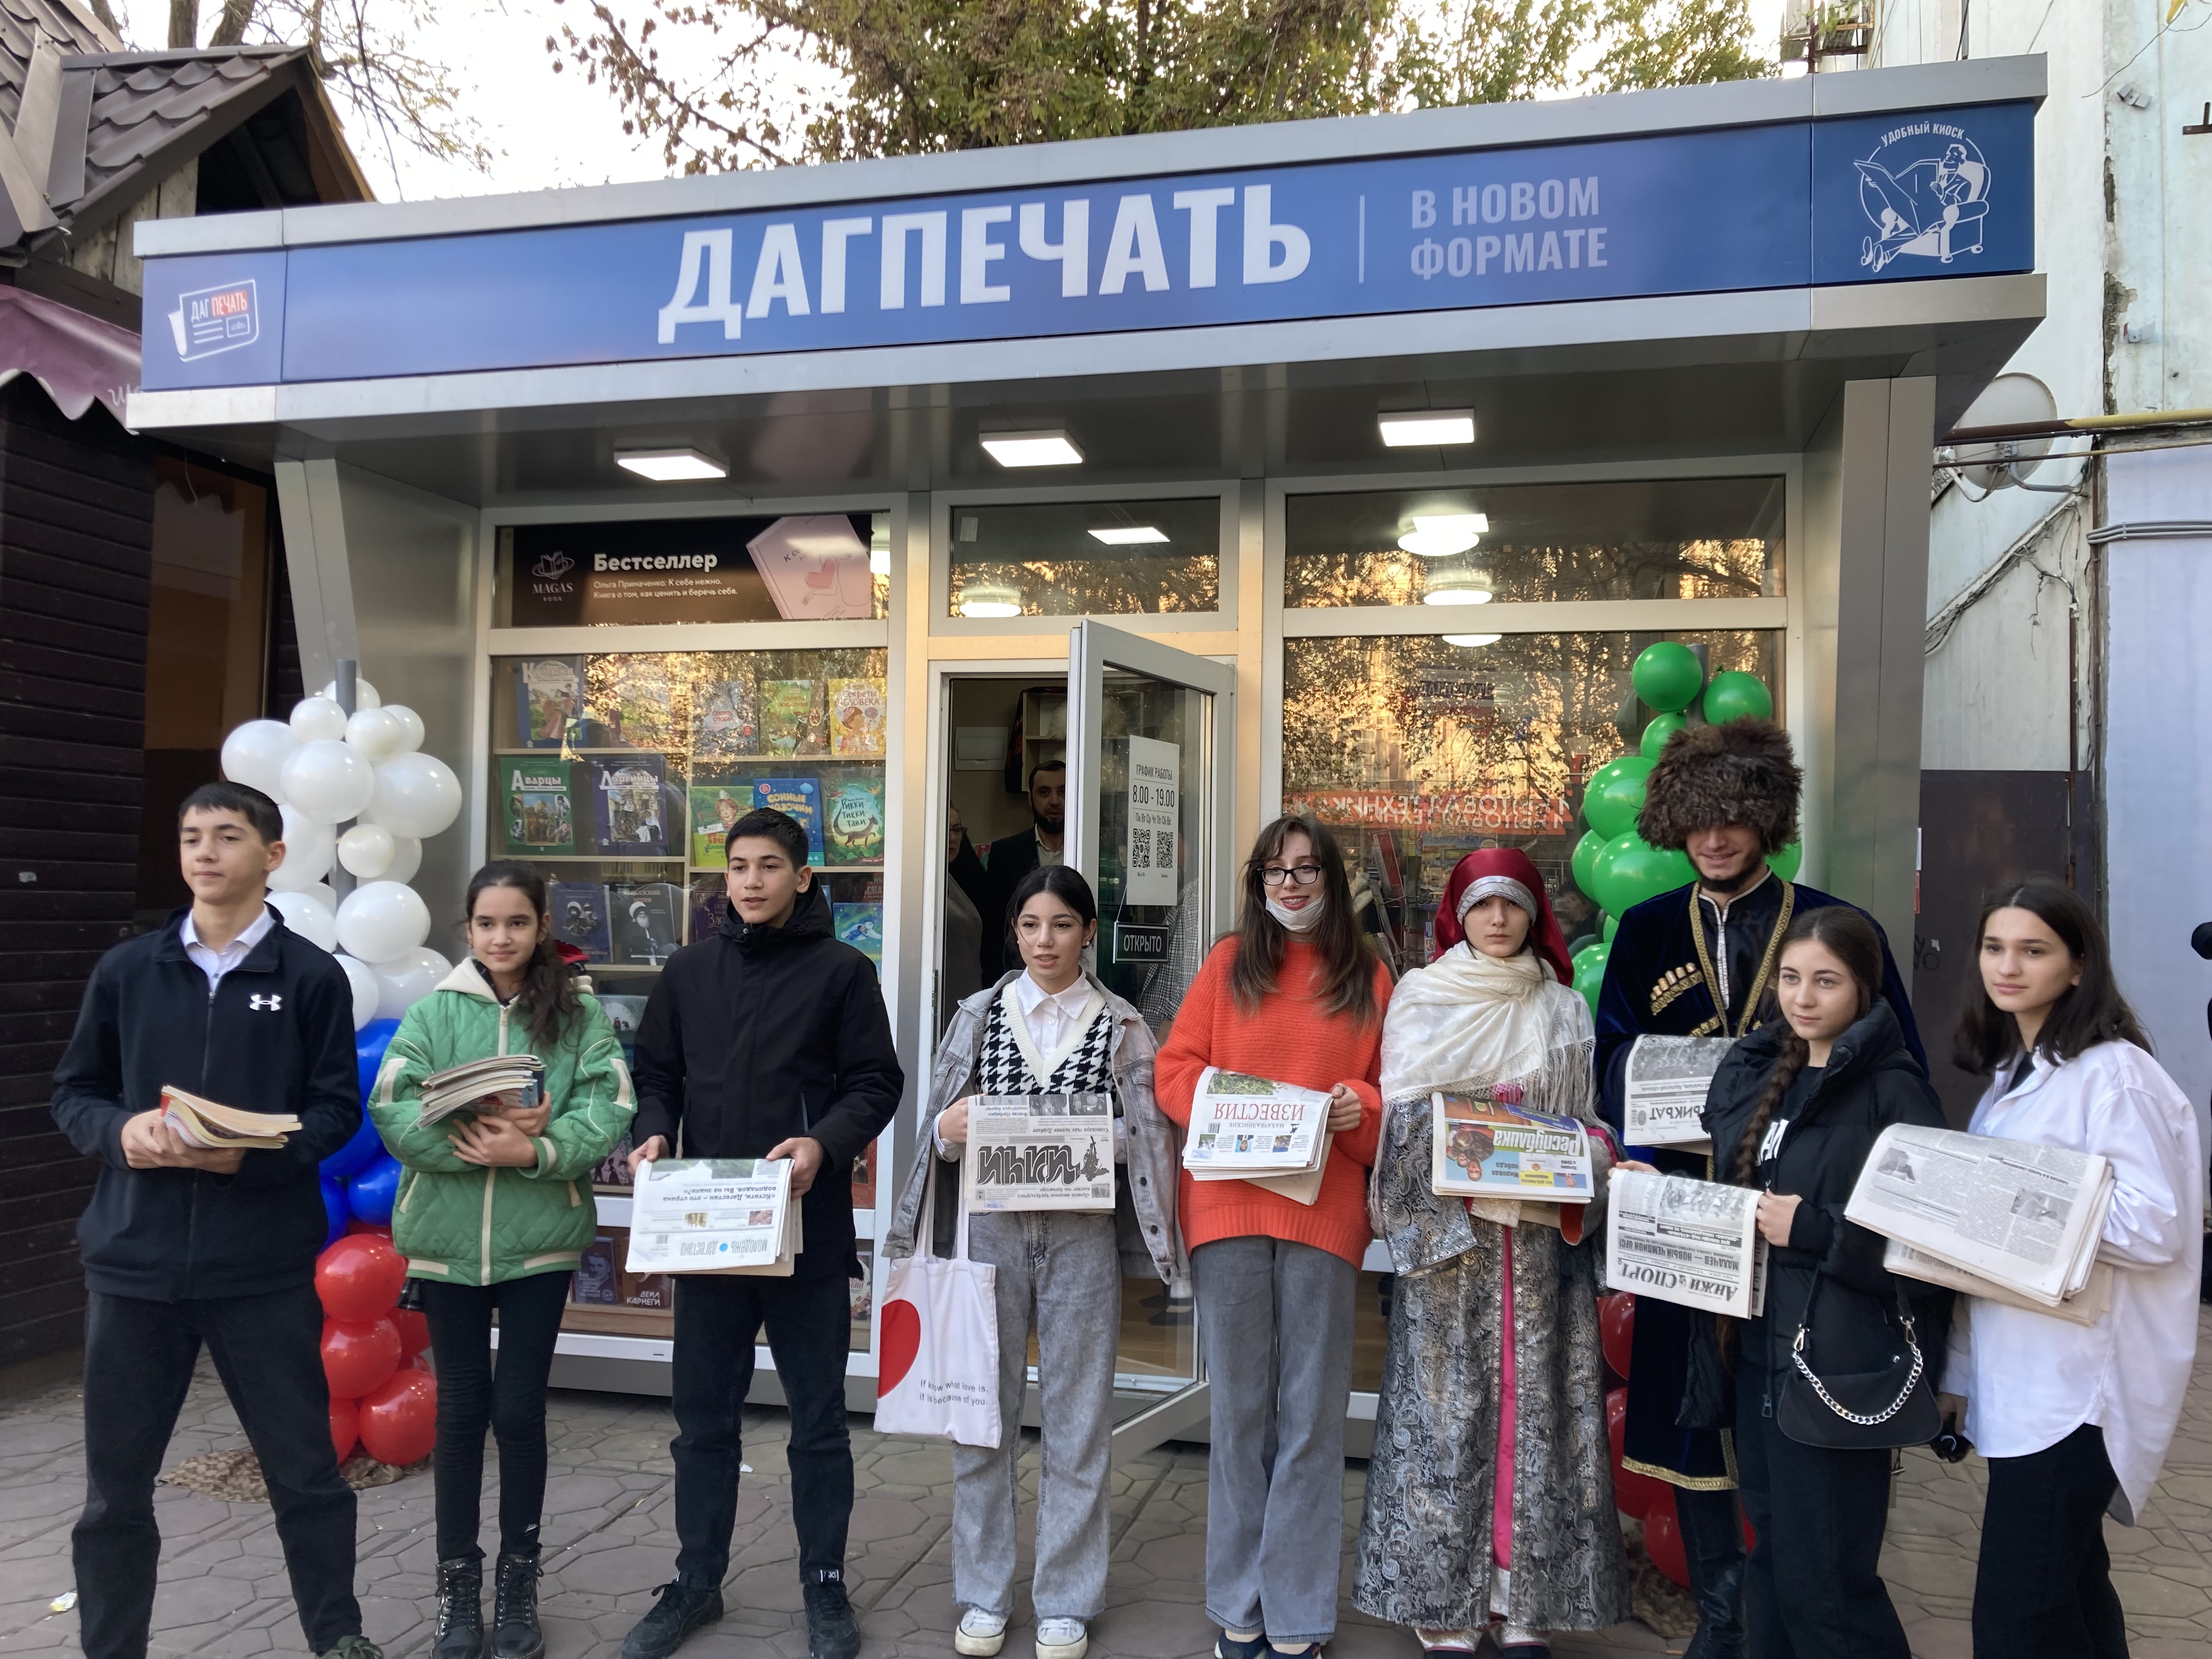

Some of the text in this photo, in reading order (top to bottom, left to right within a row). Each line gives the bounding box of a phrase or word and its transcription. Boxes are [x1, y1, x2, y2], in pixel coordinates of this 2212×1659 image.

[1881, 120, 1965, 147] УДОБНЫЙ КИОСК
[1412, 176, 1599, 229] В НОВОМ
[1410, 227, 1608, 281] ФОРМАТЕ
[657, 184, 1311, 344] ДАГПЕЧАТЬ
[190, 292, 247, 323] ДАГ ПЕЧАТЬ
[593, 553, 718, 573] Бестселлер
[532, 583, 574, 594] MAGAS
[654, 590, 681, 599] ценить
[689, 588, 716, 597] беречь
[717, 588, 738, 596] себя.
[1136, 764, 1172, 780] ГРАФИК РАБОТЫ
[1132, 785, 1149, 804] 8.00
[1156, 788, 1175, 808] 19.00
[1123, 934, 1162, 952] ОТКРЫТО
[1214, 1103, 1305, 1121] ИЗВЕСТИЯ
[1493, 1130, 1581, 1157] Республика
[1618, 1238, 1633, 1249] UFC!
[1634, 1242, 1666, 1256] ЧЕМПИОН
[1667, 1250, 1692, 1262] НОВЫЙ
[1704, 1255, 1739, 1271] МАХАЧЕВ
[1620, 1263, 1677, 1289] СПОРТ
[627, 1297, 661, 1307] КАРНЕГИ
[945, 1380, 961, 1390] what
[962, 1382, 975, 1392] love
[927, 1393, 933, 1402] is
[934, 1395, 961, 1404] because
[963, 1396, 969, 1404] of
